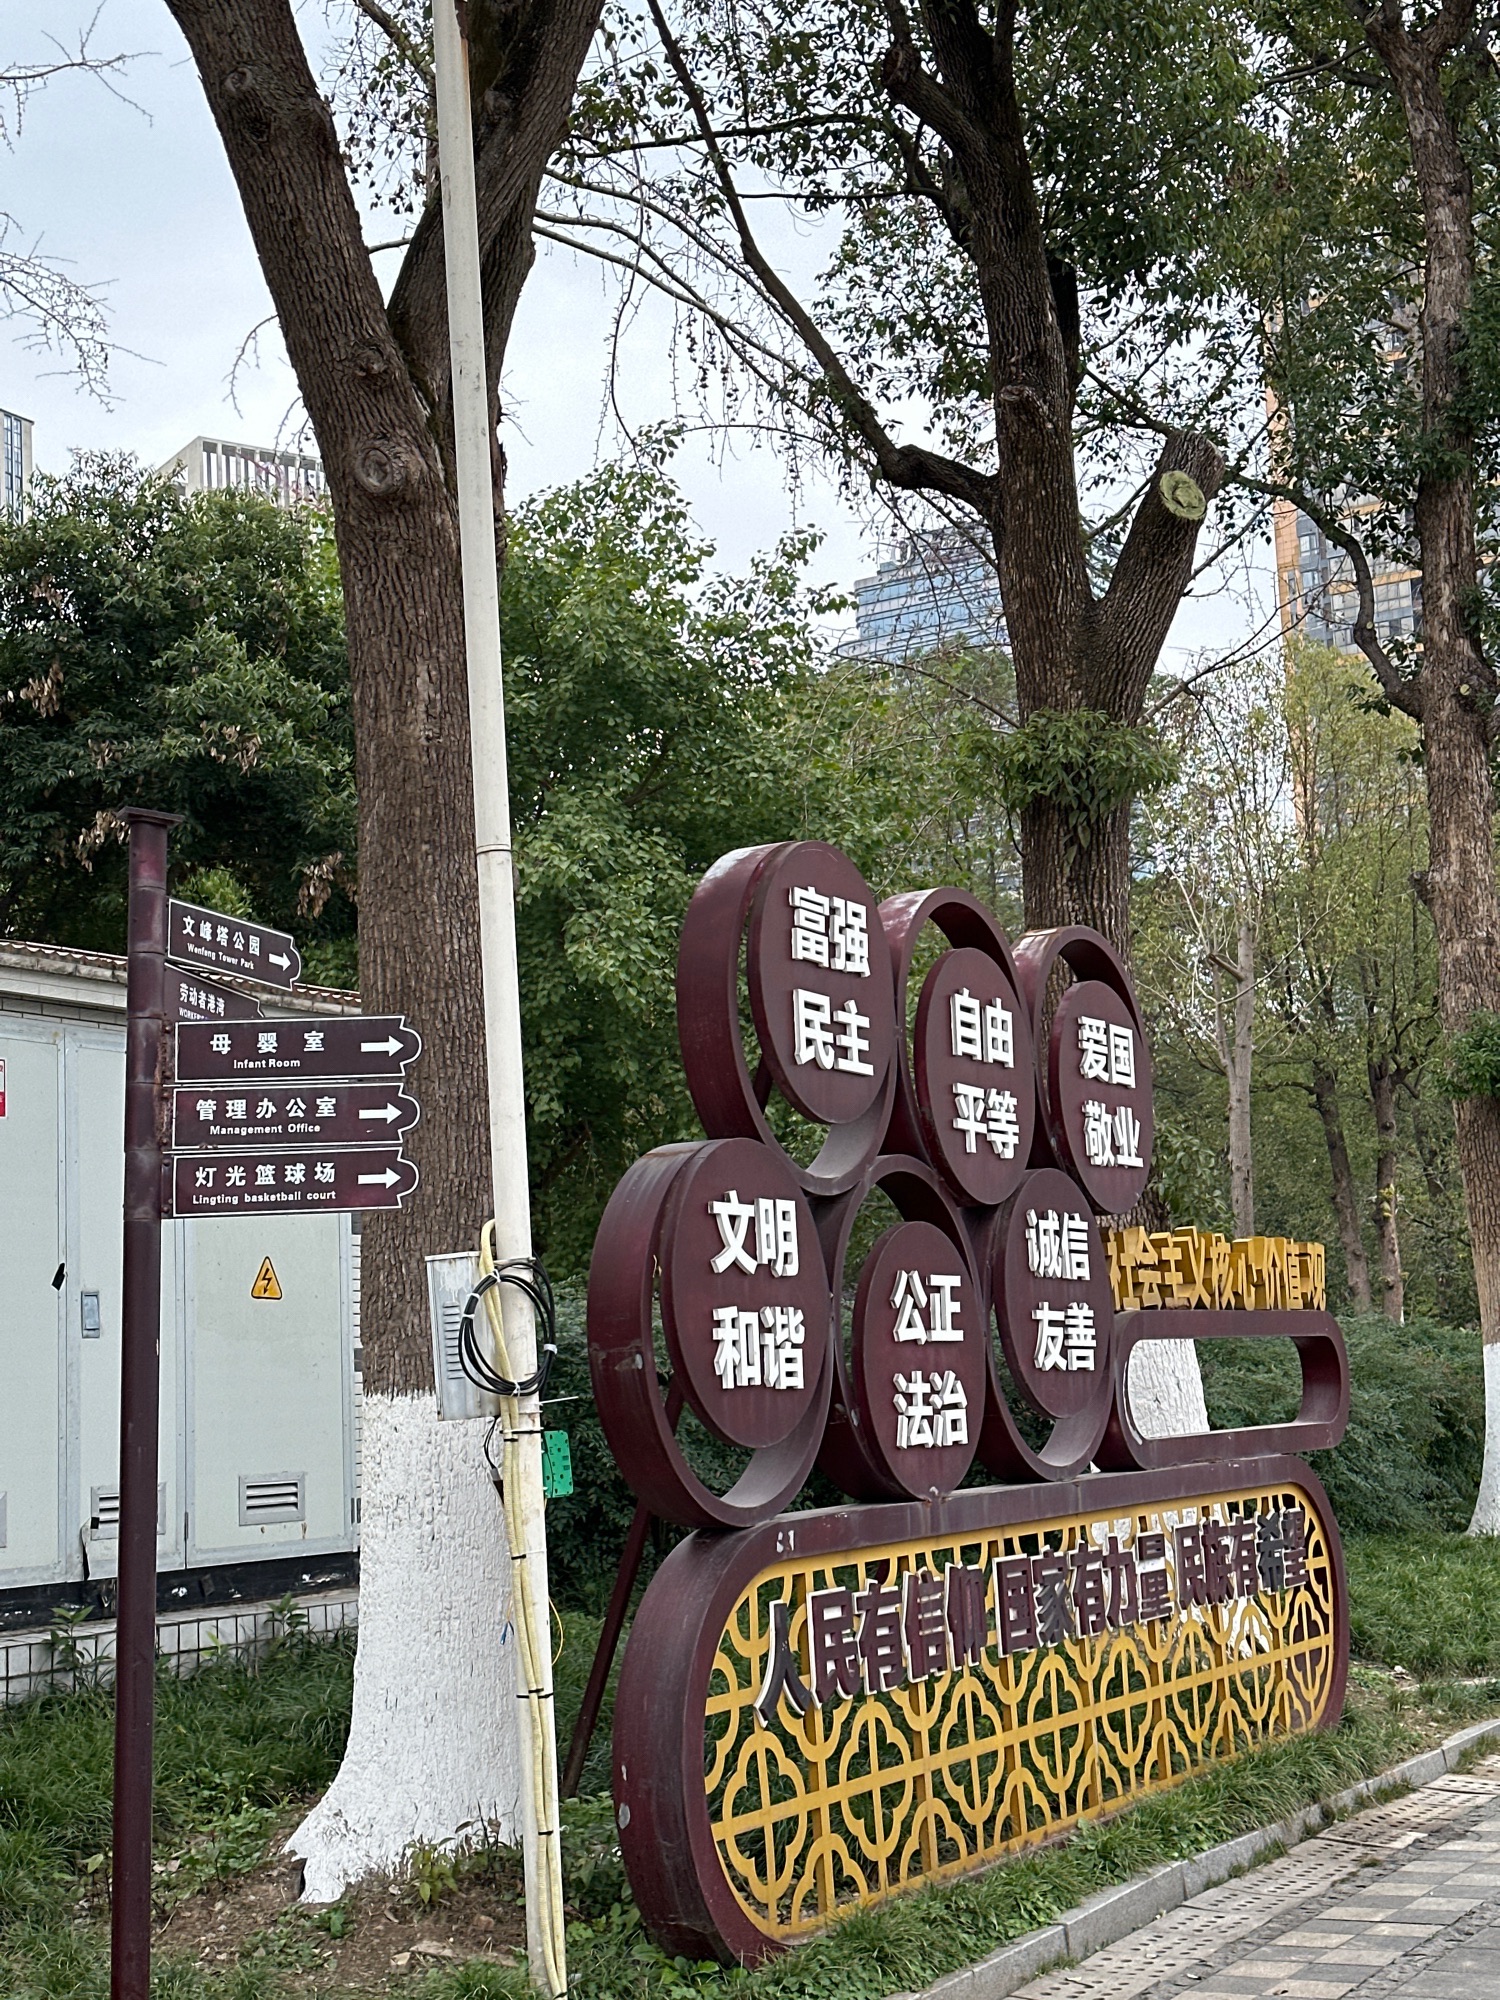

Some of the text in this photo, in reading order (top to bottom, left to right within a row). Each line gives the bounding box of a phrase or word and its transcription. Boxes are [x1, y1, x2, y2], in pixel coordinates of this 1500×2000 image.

[182, 915, 260, 957] 文峰塔公园
[187, 943, 255, 970] Wenfeng Tower Park
[789, 886, 871, 977] 富强
[180, 982, 225, 1017] 劳动者港湾
[793, 988, 874, 1076] 民主
[950, 987, 1015, 1068] 自由
[210, 1031, 325, 1054] 母婴室
[234, 1058, 301, 1069] Infant Room
[1078, 1016, 1136, 1089] 爱国
[196, 1096, 337, 1121] 管理办公室
[210, 1123, 321, 1136] Management Office
[953, 1082, 1020, 1160] 平等
[1082, 1100, 1144, 1169] 敬业
[193, 1190, 337, 1206] Lingting basketball court
[195, 1161, 336, 1188] 灯光篮球场
[708, 1189, 799, 1278] 文明
[1025, 1208, 1091, 1281] 诚信
[890, 1270, 964, 1345] 公正
[1032, 1302, 1097, 1372] 友善
[712, 1305, 805, 1390] 和谐
[893, 1370, 969, 1449] 法治
